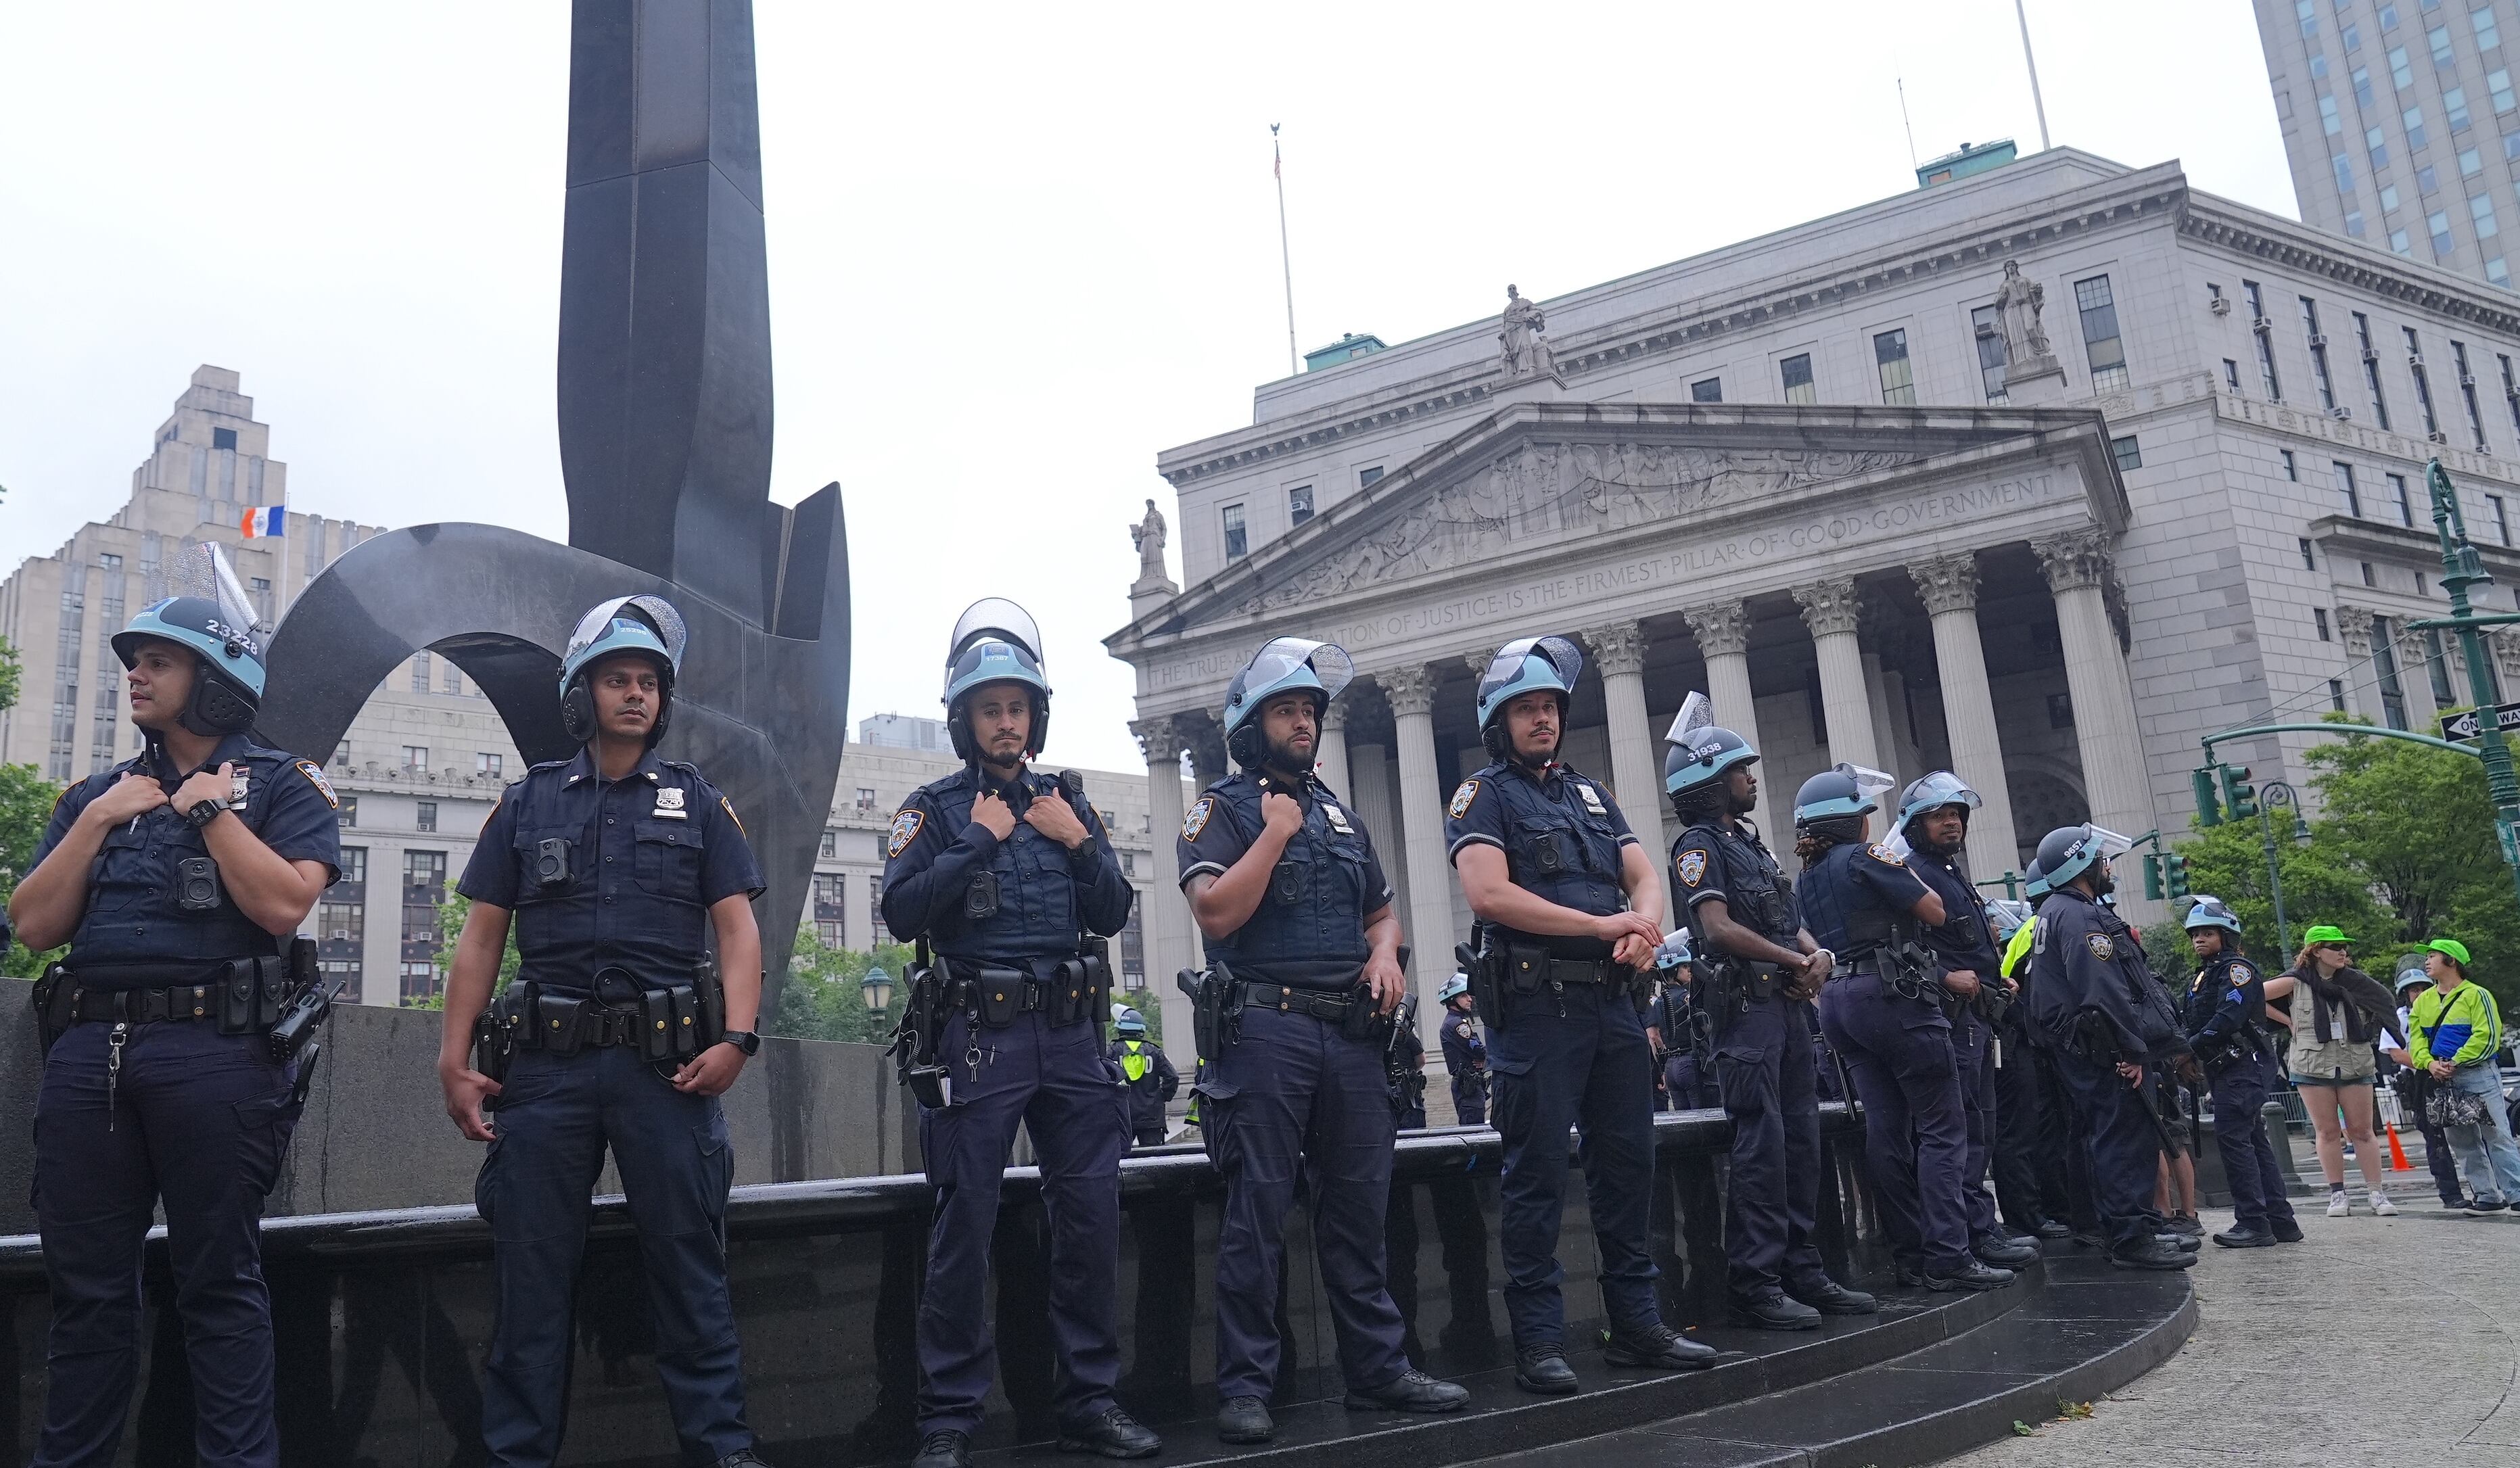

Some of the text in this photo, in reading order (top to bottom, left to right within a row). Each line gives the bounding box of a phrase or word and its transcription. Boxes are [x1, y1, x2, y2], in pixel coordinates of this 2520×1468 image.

[1152, 666, 1183, 686] THE
[1187, 659, 1228, 679] TRUE
[1387, 615, 1411, 634] OF
[1418, 595, 1499, 629] JUSTICE
[1506, 590, 1524, 609] IS
[1529, 580, 1568, 605] THE
[1575, 559, 1662, 595] FIRMEST
[1671, 543, 1744, 575] PILLAR
[1749, 534, 1779, 556] OF
[1789, 517, 1862, 547] GOOD
[1872, 475, 2052, 529] GOVERNMENT
[205, 619, 258, 655] 23228
[2461, 710, 2520, 731] ON WA
[1687, 742, 1722, 761] 31938
[2063, 839, 2082, 858] 9657
